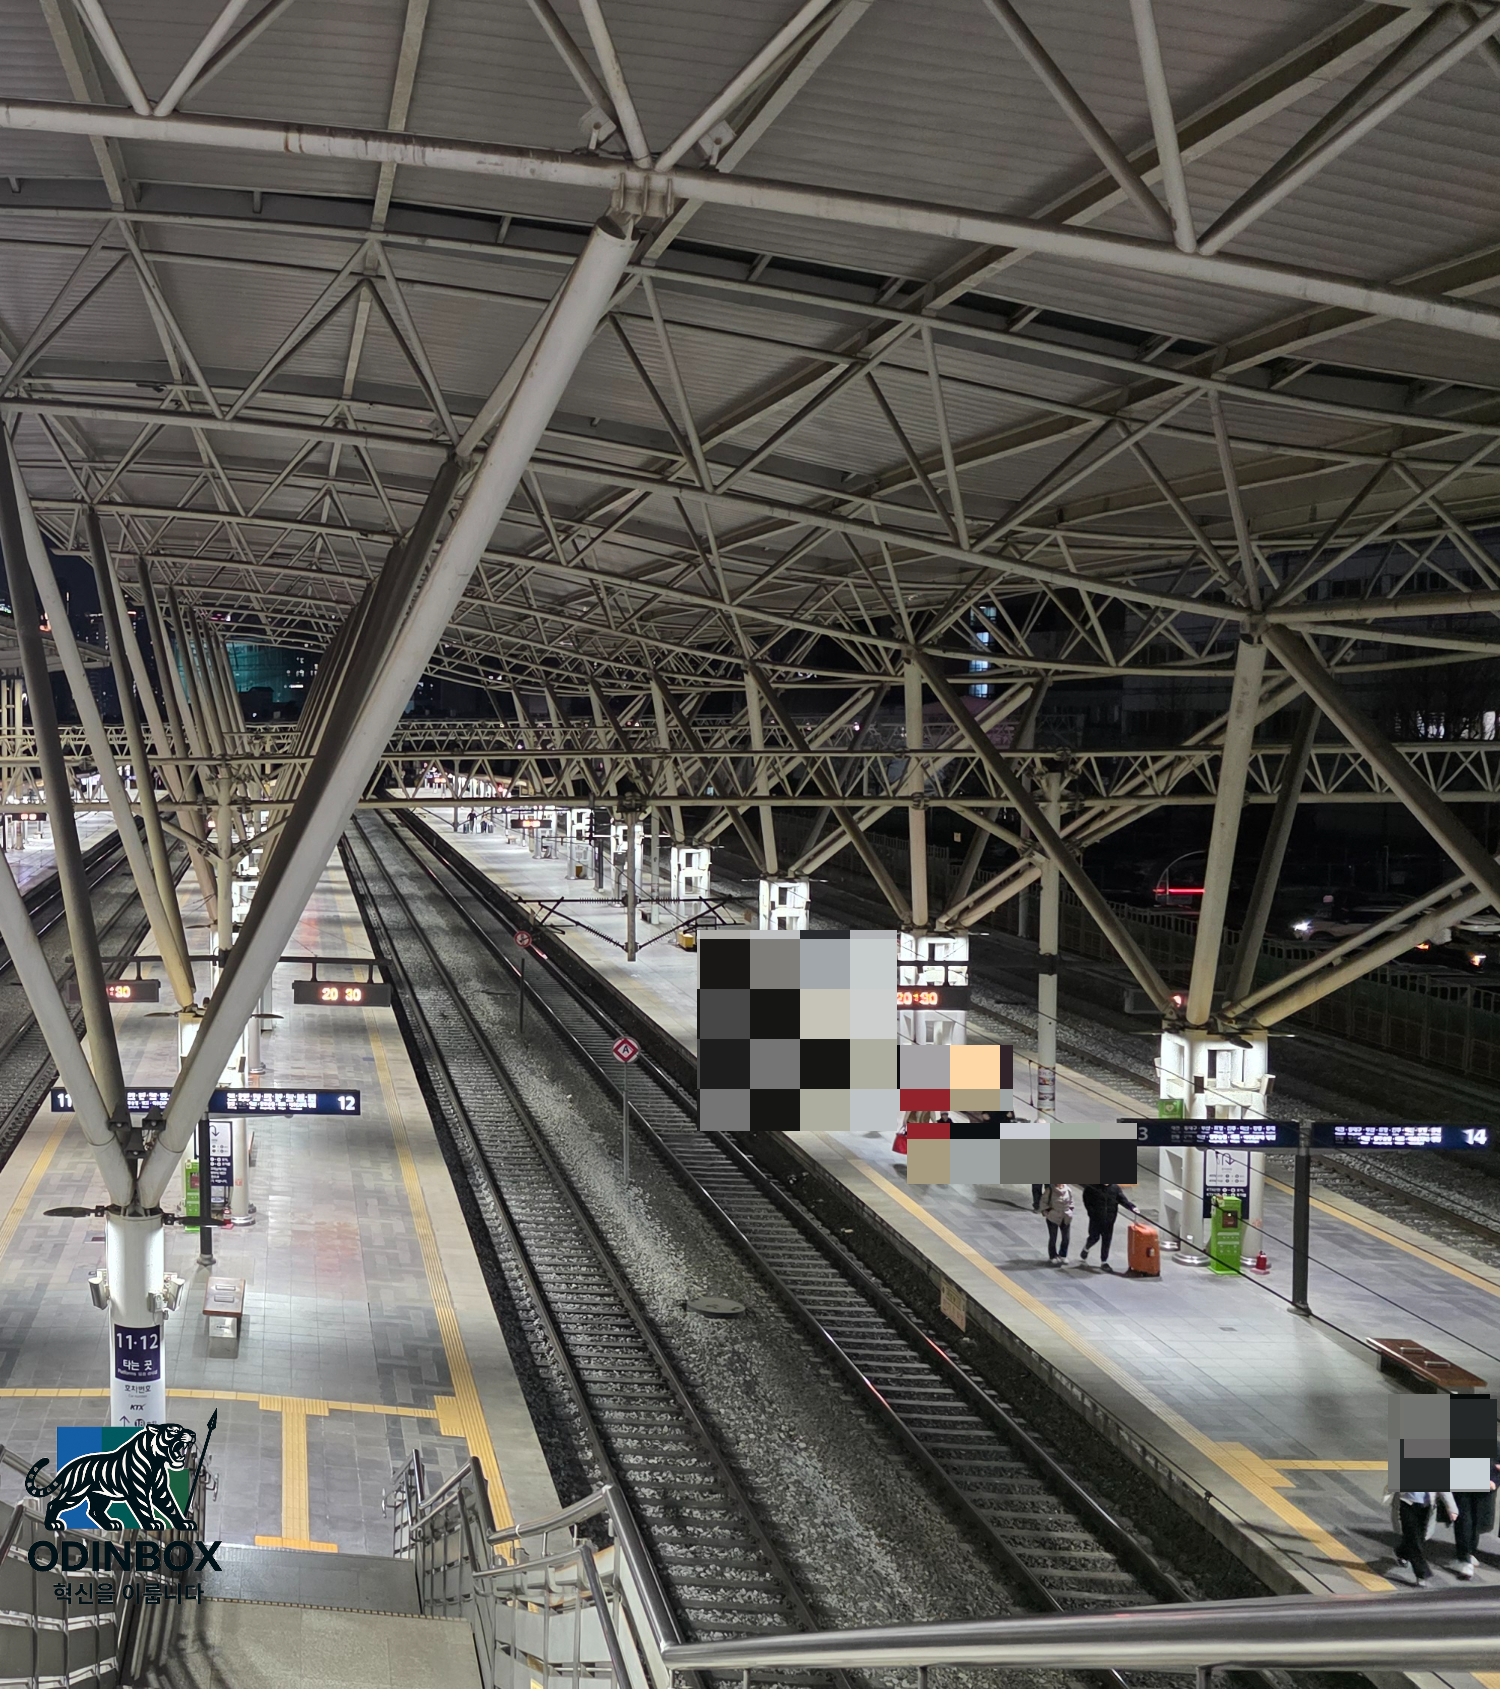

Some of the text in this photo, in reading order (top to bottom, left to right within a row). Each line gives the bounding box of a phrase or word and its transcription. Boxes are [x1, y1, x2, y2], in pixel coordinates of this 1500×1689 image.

[107, 985, 131, 999] :30
[622, 1044, 630, 1054] A
[56, 1092, 73, 1108] 11
[337, 1095, 356, 1111] 12
[1461, 1128, 1488, 1145] 14
[122, 1359, 153, 1371] 타는 곳
[124, 1384, 152, 1394] 호차번호
[130, 1403, 146, 1411] KTX
